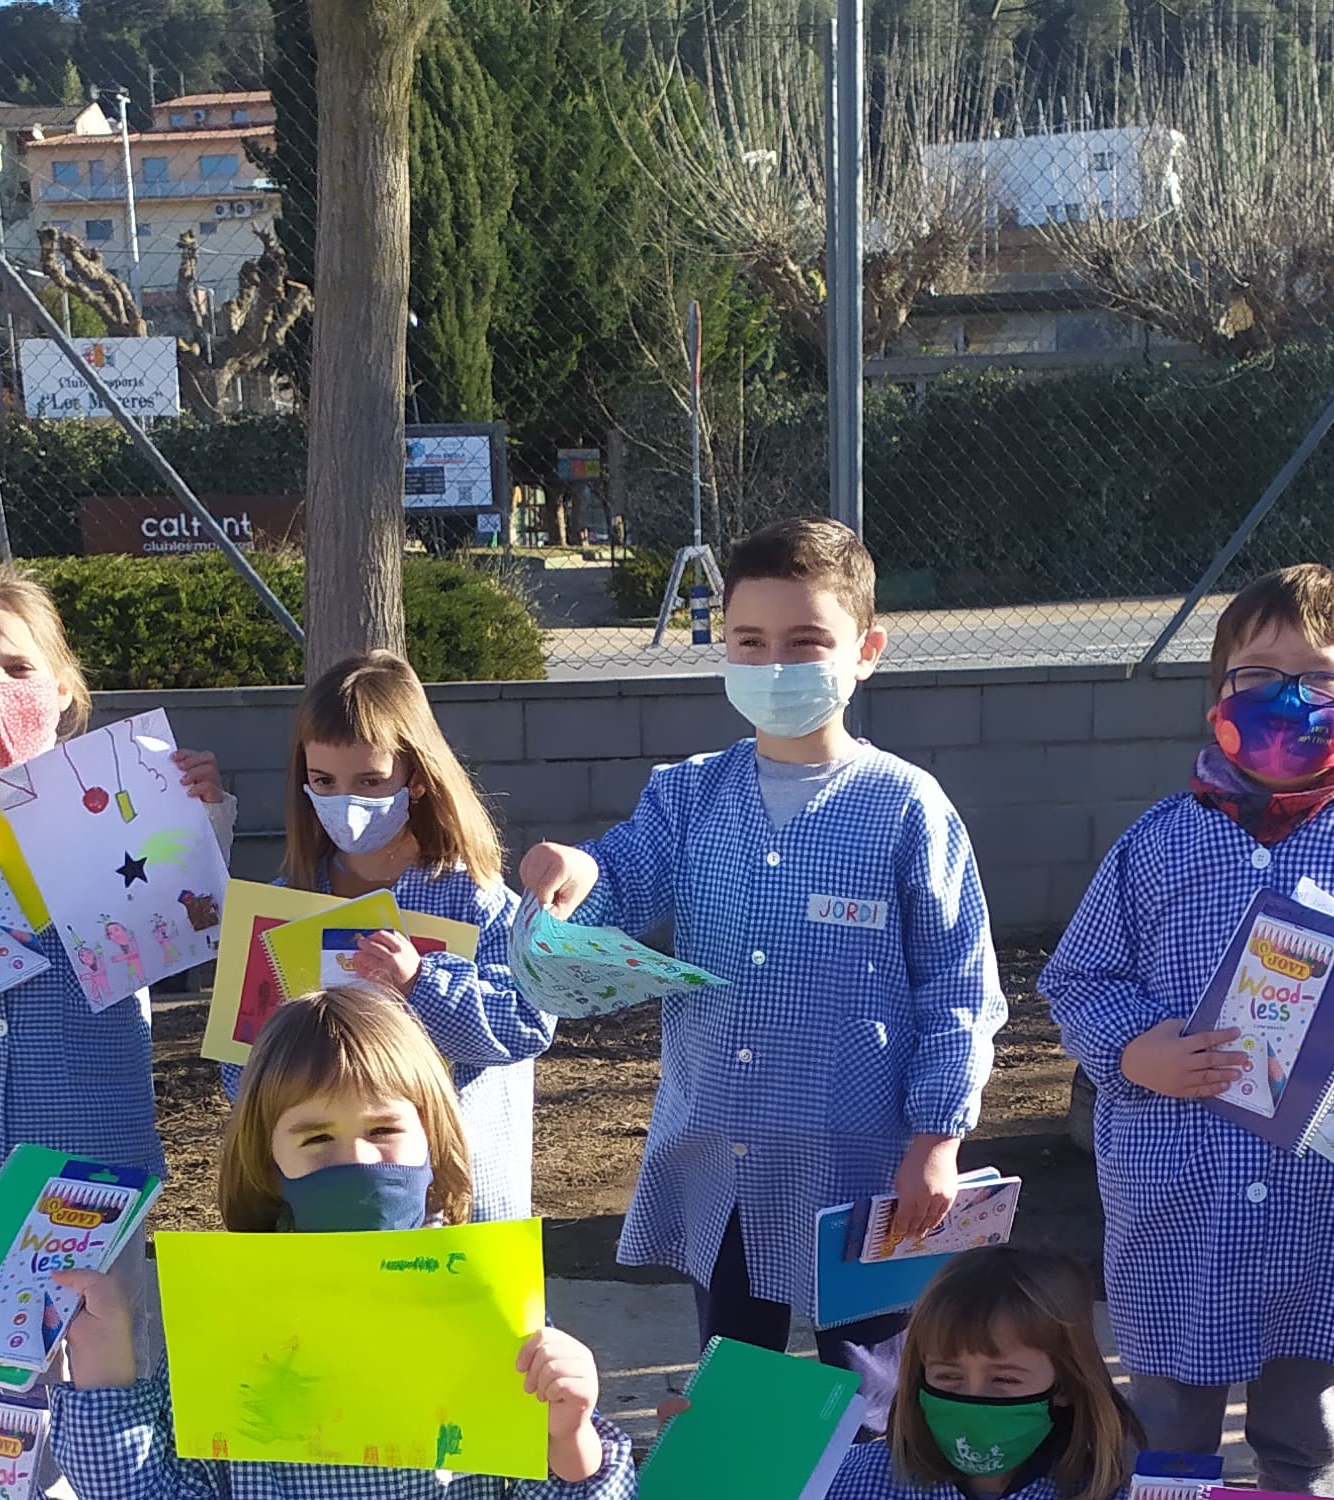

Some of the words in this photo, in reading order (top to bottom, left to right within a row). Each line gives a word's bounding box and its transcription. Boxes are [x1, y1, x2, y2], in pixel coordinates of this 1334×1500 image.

[818, 898, 878, 924] JORDI
[1267, 954, 1307, 976] JOVI
[1238, 965, 1316, 1004] Wood-
[1249, 997, 1292, 1022] less
[56, 1210, 99, 1226] JOVI
[19, 1224, 105, 1254] Wood-
[30, 1252, 76, 1275] less
